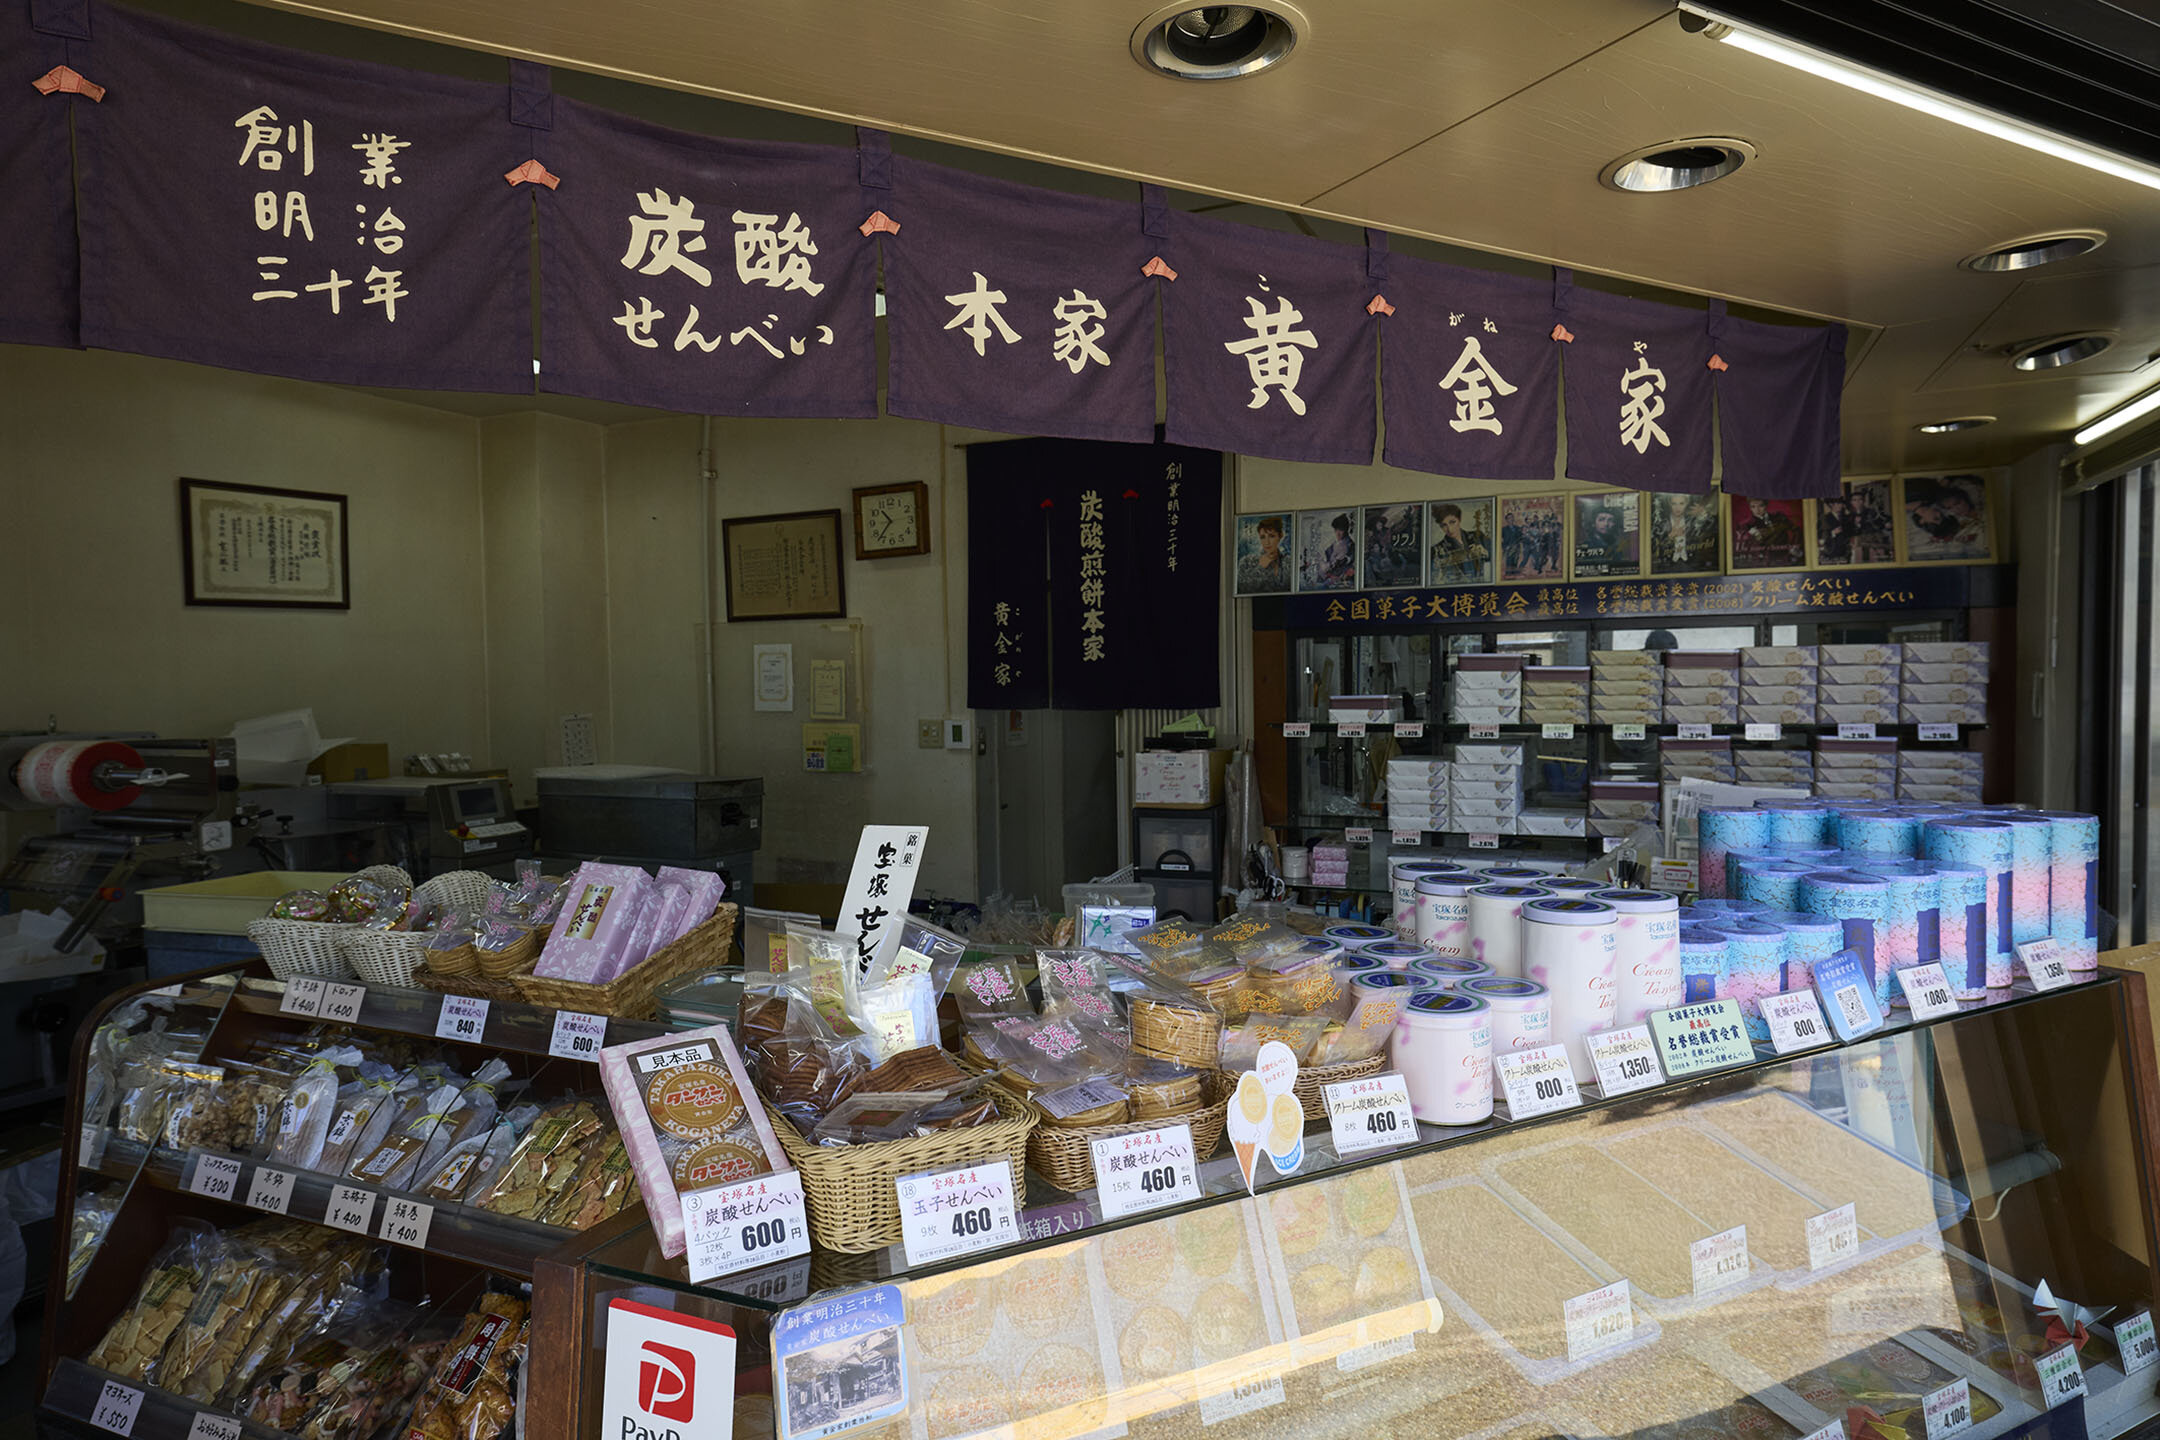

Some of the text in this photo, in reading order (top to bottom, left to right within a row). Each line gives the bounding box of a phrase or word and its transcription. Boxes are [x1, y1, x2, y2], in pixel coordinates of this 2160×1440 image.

[235, 104, 411, 189] 創業
[254, 190, 406, 255] 明治
[620, 187, 825, 297] 炭酸
[251, 255, 409, 323] 三十年
[611, 296, 834, 360] せんべい
[944, 271, 1112, 375] 本家
[1166, 462, 1183, 573] 創業明治三十年
[1079, 490, 1107, 662] 炭酸煎餅本家
[1750, 577, 1852, 594] 炭酸せんべい
[1326, 591, 1530, 623] 全国菓子大博覧会
[1750, 591, 1915, 609] クリーム炭酸せんべい
[993, 601, 1013, 687] 黄金家
[902, 834, 919, 866] 銘菓
[570, 904, 592, 933] せんべい
[327, 1003, 353, 1017] ¥400
[1668, 1004, 1725, 1023] 全国菓子大博覧会
[456, 1019, 475, 1035] 840
[1689, 1018, 1711, 1030] 最高位
[1794, 1018, 1816, 1037] 800
[573, 1036, 593, 1053] 600
[1668, 1025, 1740, 1051] 名誉総裁賞受賞
[652, 1049, 702, 1069] 見本品
[1691, 1046, 1727, 1057] 炭酸せんべい
[1695, 1051, 1750, 1068] クリーム炭酸せんべい
[1504, 1059, 1568, 1080] クリーム炭酸せんべい
[1619, 1056, 1650, 1080] 1,350
[650, 1061, 736, 1105] TAKARAZUKA
[664, 1083, 724, 1106] タンサン
[1350, 1081, 1383, 1095] 宝塚名産
[1535, 1077, 1563, 1100] 800
[1333, 1093, 1407, 1114] クリーム炭酸せんべい
[663, 1104, 745, 1137] KOGANEYA
[1367, 1110, 1397, 1134] 460
[1401, 1119, 1410, 1129] 円
[1122, 1132, 1162, 1149] 宝塚名産
[675, 1133, 764, 1181] TAKARAZUKA
[1109, 1146, 1187, 1172] 炭酸せんべい
[690, 1158, 752, 1182] タンサン
[931, 1171, 978, 1191] 宝塚名産
[1112, 1181, 1132, 1193] 15枚
[1141, 1165, 1176, 1194] 460
[1182, 1174, 1192, 1186] 円
[202, 1175, 230, 1194] ¥300
[718, 1182, 768, 1204] 宝塚名産
[254, 1191, 281, 1210] ¥400
[705, 1192, 800, 1227] 炭酸せんべい
[913, 1185, 1003, 1216] 玉子せんべい
[333, 1208, 362, 1227] ¥400
[921, 1225, 938, 1238] 9枚
[952, 1207, 992, 1237] 460
[999, 1216, 1010, 1228] 円
[388, 1223, 418, 1242] ¥400
[741, 1218, 786, 1252] 600
[791, 1226, 802, 1240] 円
[705, 1242, 724, 1254] 12枚
[787, 1292, 887, 1331] 創業明治三十年
[808, 1313, 890, 1345] 炭酸せんべい
[2133, 1336, 2155, 1359] 5,000
[2058, 1371, 2080, 1394] 4,200
[105, 1385, 132, 1406] マヨネーズ
[99, 1406, 128, 1430] ¥550
[1944, 1405, 1966, 1429] 4,100
